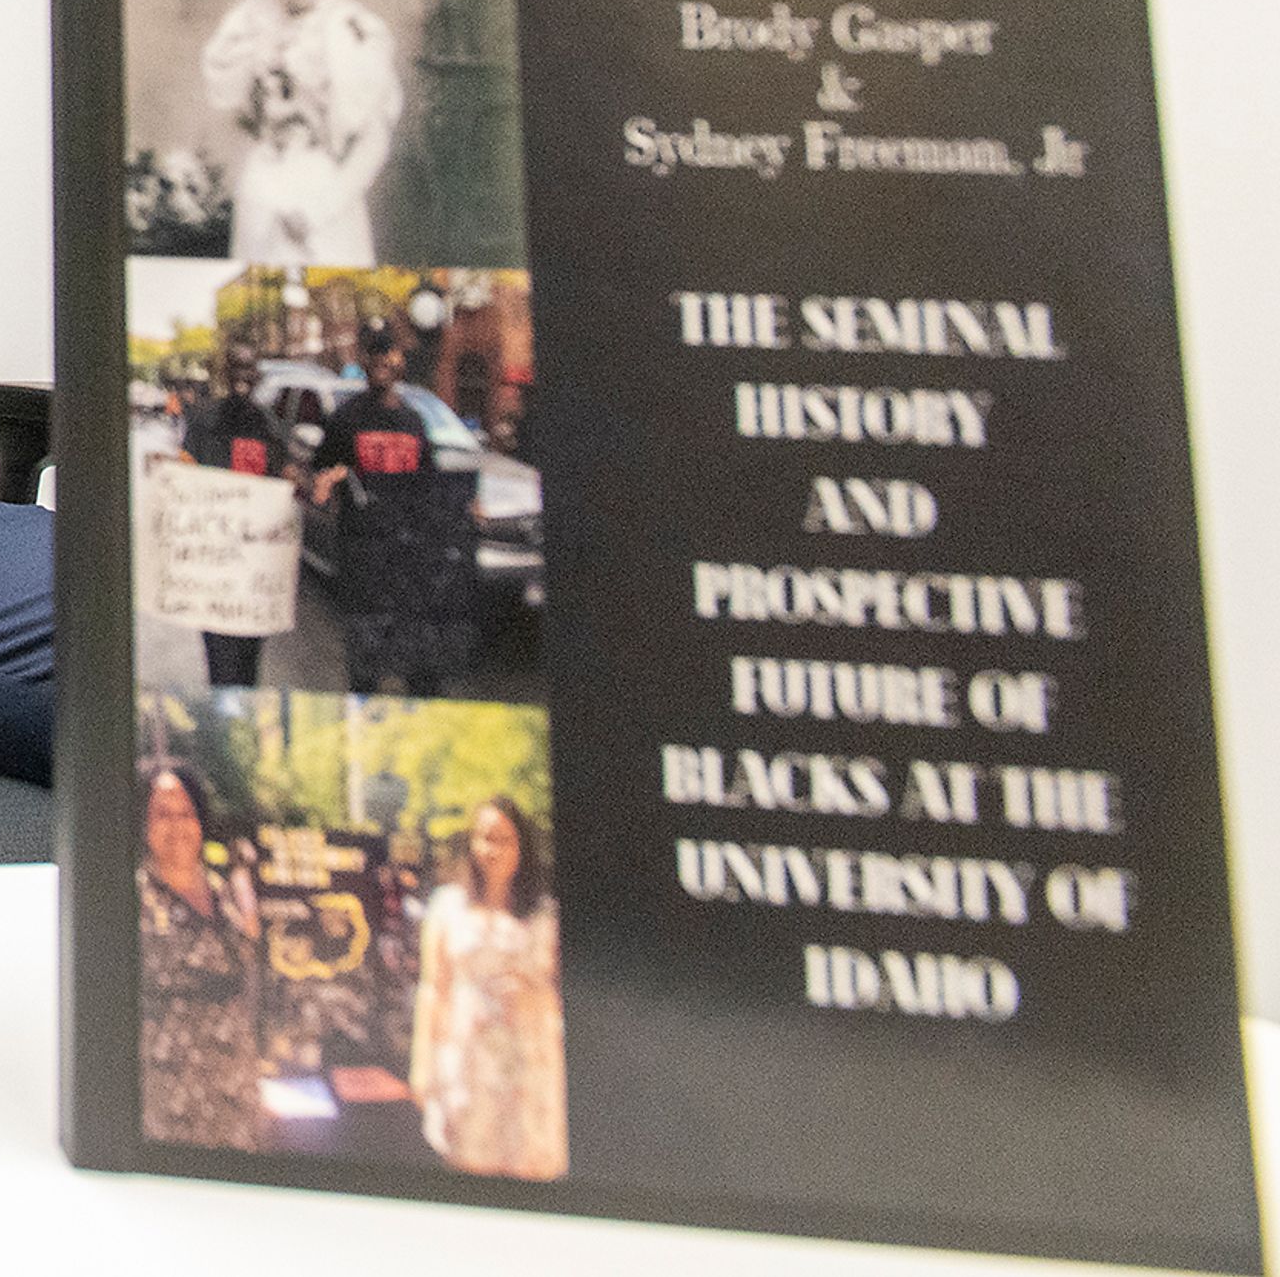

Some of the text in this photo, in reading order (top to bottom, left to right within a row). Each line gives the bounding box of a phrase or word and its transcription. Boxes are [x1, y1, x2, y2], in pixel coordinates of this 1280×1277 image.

[678, 0, 820, 62] Brody
[815, 62, 863, 112] &
[623, 115, 792, 180] Sydney
[670, 289, 1068, 362] THE SEMINAL
[735, 380, 992, 449] HISTORY
[803, 475, 940, 538] AND
[693, 559, 1086, 642] PROSPECTIVE
[731, 653, 1060, 734] FUTURE OF
[660, 742, 1124, 835] BLACKS AT THE
[674, 837, 1138, 933] UNIVERSITY OF
[804, 943, 1022, 1025] IDAHO
